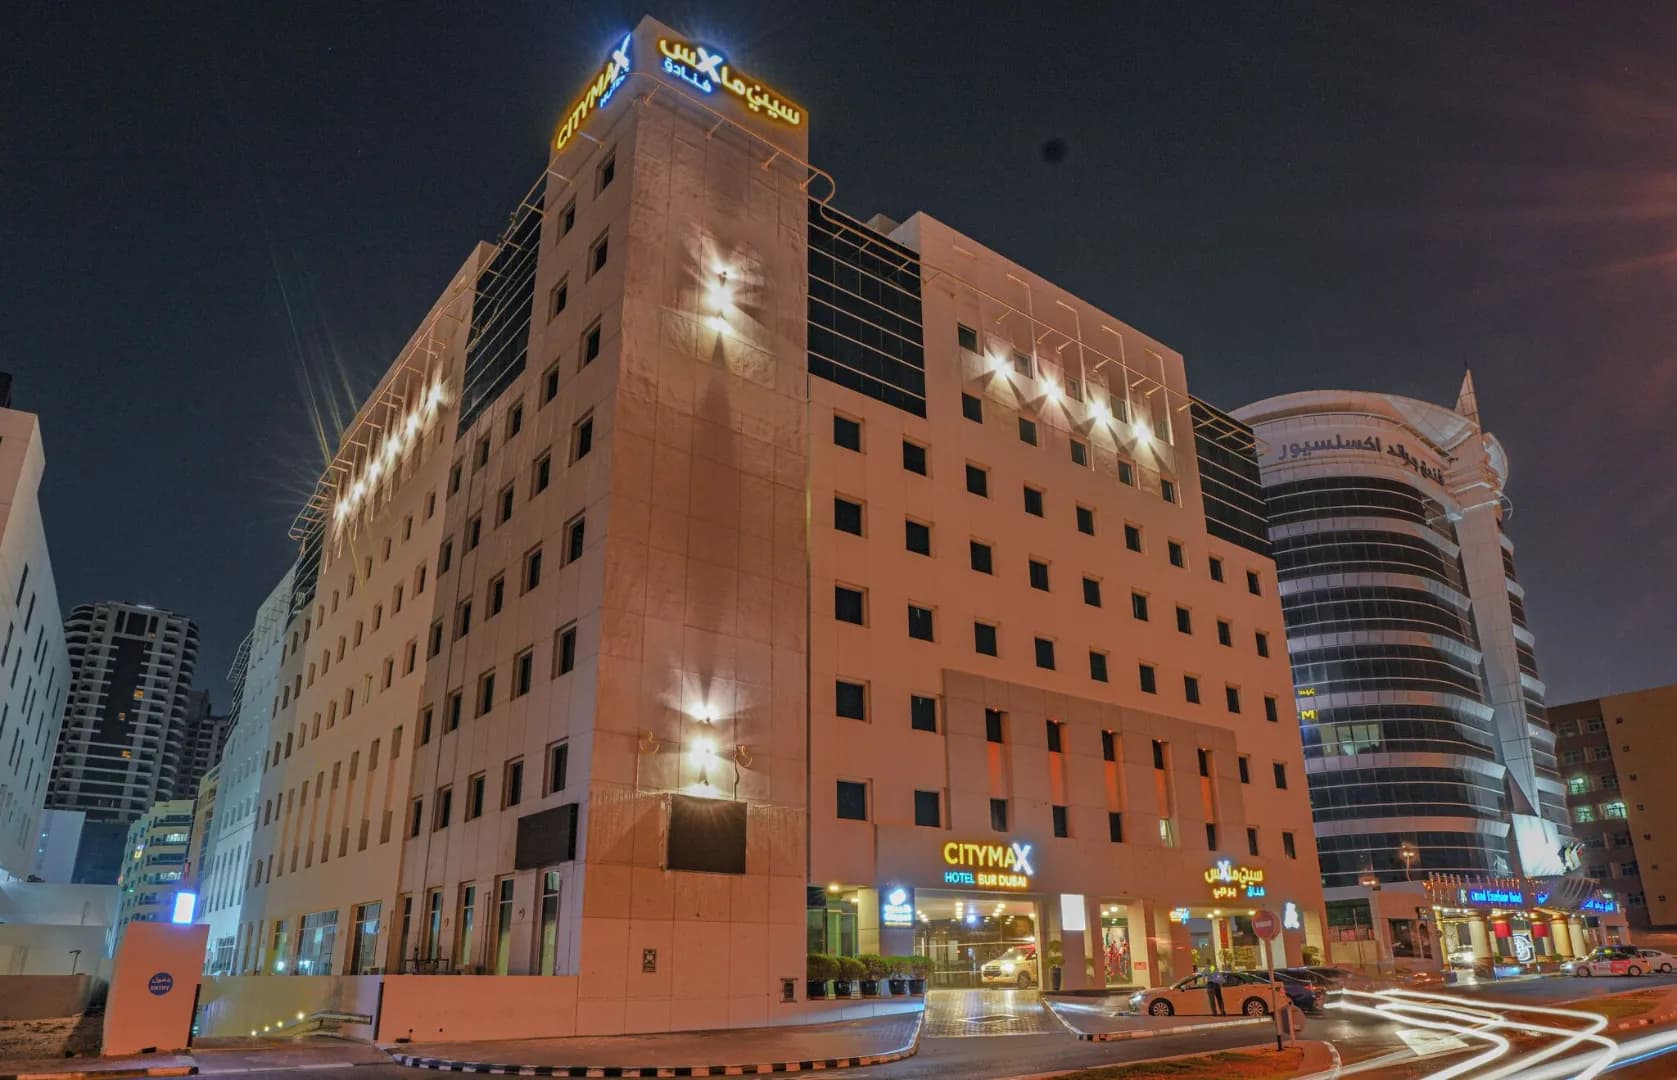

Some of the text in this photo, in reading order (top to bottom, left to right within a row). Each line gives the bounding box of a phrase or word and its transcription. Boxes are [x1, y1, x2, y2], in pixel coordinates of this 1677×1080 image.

[556, 32, 631, 150] CITYMAX
[944, 842, 1034, 875] CITYMAX
[944, 872, 1027, 888] HOTEL BUR DUBAI
